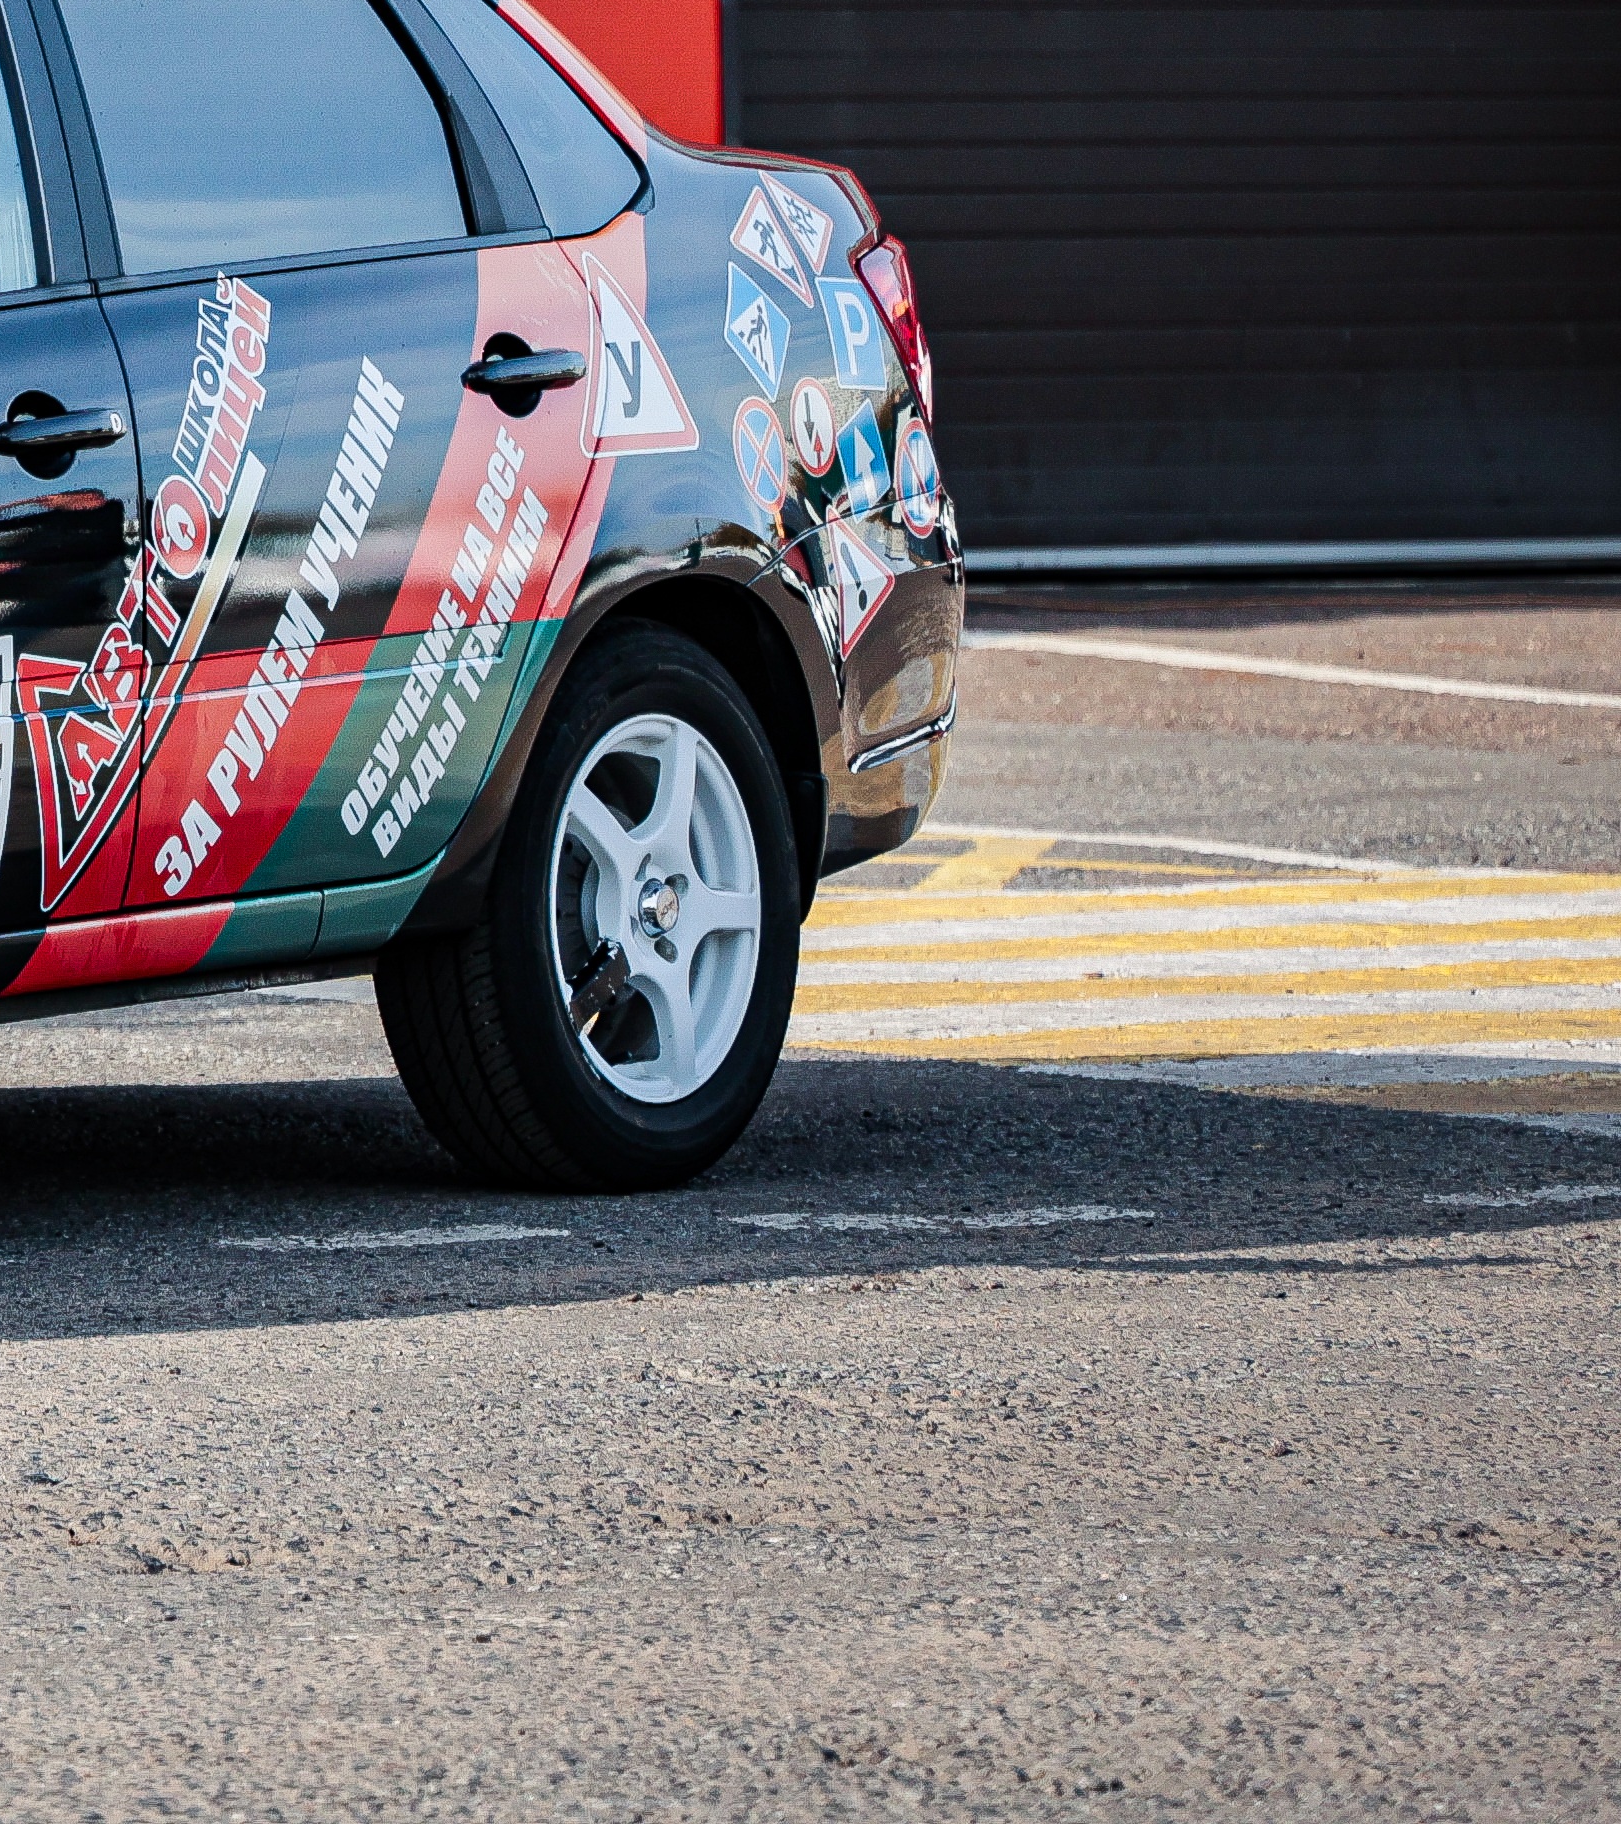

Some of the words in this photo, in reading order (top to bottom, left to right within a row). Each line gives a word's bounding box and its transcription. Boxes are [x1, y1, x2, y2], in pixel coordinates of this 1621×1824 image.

[171, 296, 230, 470] ШКОЛА
[154, 805, 223, 898] ЗА
[207, 592, 328, 819] РУЛЕМ
[300, 355, 406, 611] УЧЕНИК
[340, 586, 469, 837] ОБУЧЕНИЕ
[449, 523, 496, 597] НА
[475, 425, 528, 525] ВСЕ
[371, 695, 469, 859] ВИДЫ
[454, 487, 550, 705] ТЕХНИКИ
